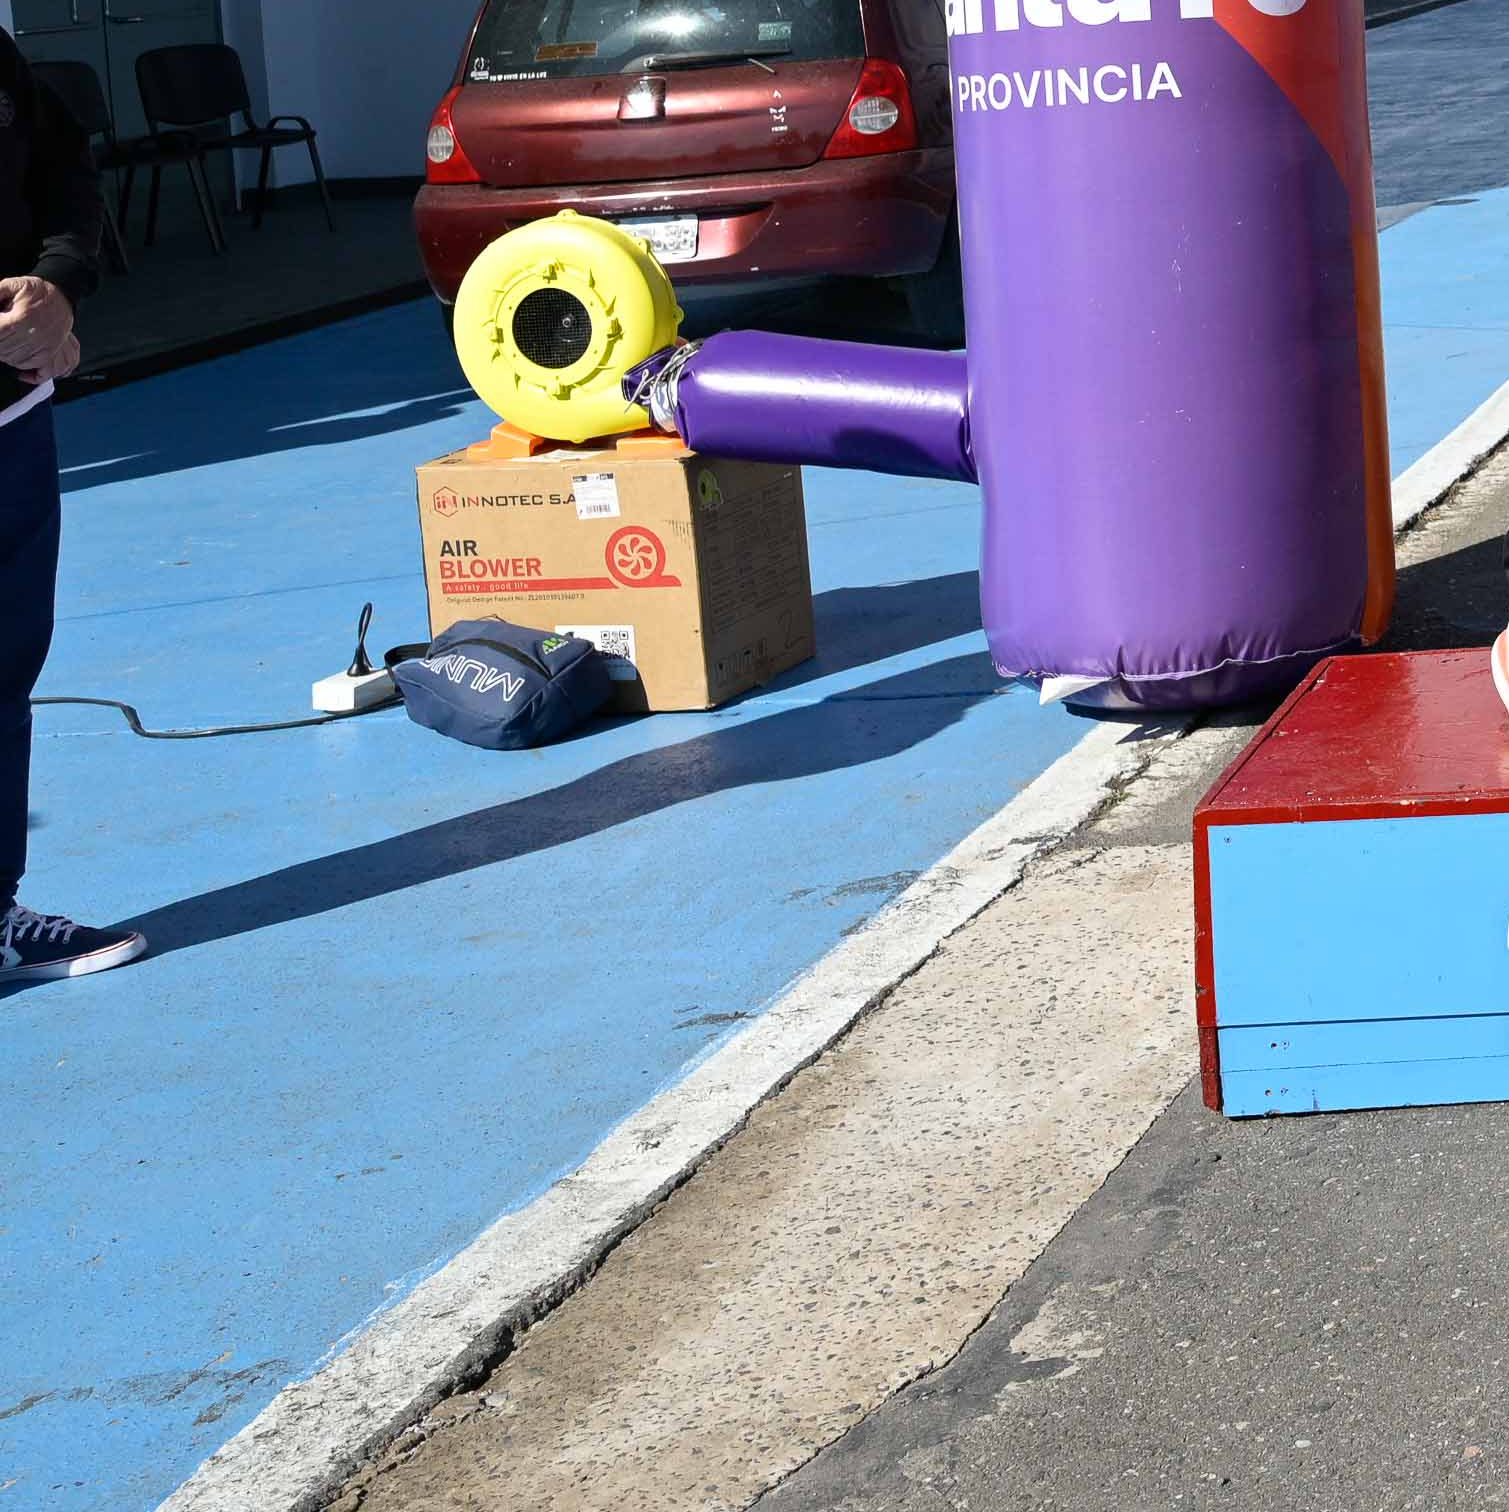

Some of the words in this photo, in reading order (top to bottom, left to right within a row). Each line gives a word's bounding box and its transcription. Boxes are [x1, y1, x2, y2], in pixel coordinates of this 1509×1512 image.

[957, 62, 1183, 113] PROVINCIA
[461, 494, 544, 509] INNOTEC
[439, 539, 478, 558] AIR
[439, 557, 542, 580] BLOWER
